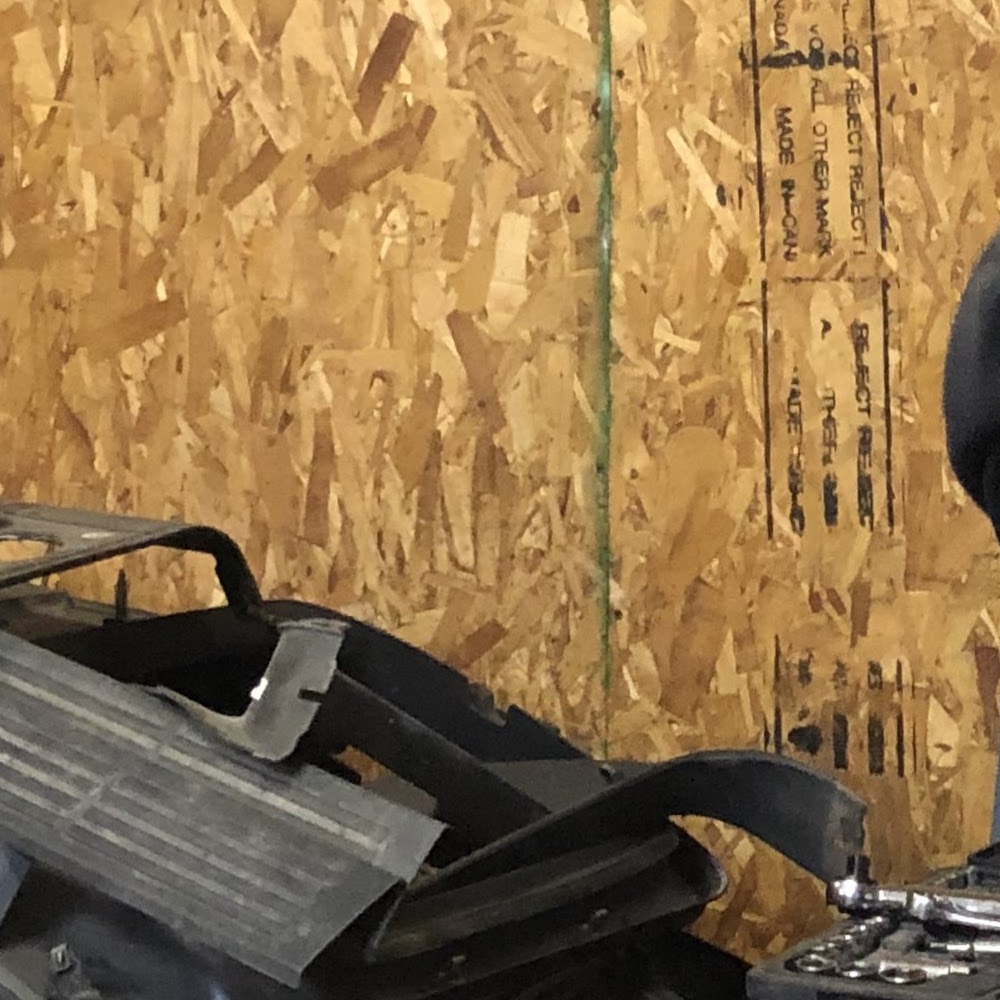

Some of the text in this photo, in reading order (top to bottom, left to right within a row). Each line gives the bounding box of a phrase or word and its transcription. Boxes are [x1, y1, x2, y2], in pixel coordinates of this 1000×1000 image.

[811, 77, 826, 113] ALL
[846, 79, 863, 157] REJECT
[776, 107, 795, 166] MADE
[812, 121, 829, 191] OTHER
[849, 165, 868, 245] REJECT
